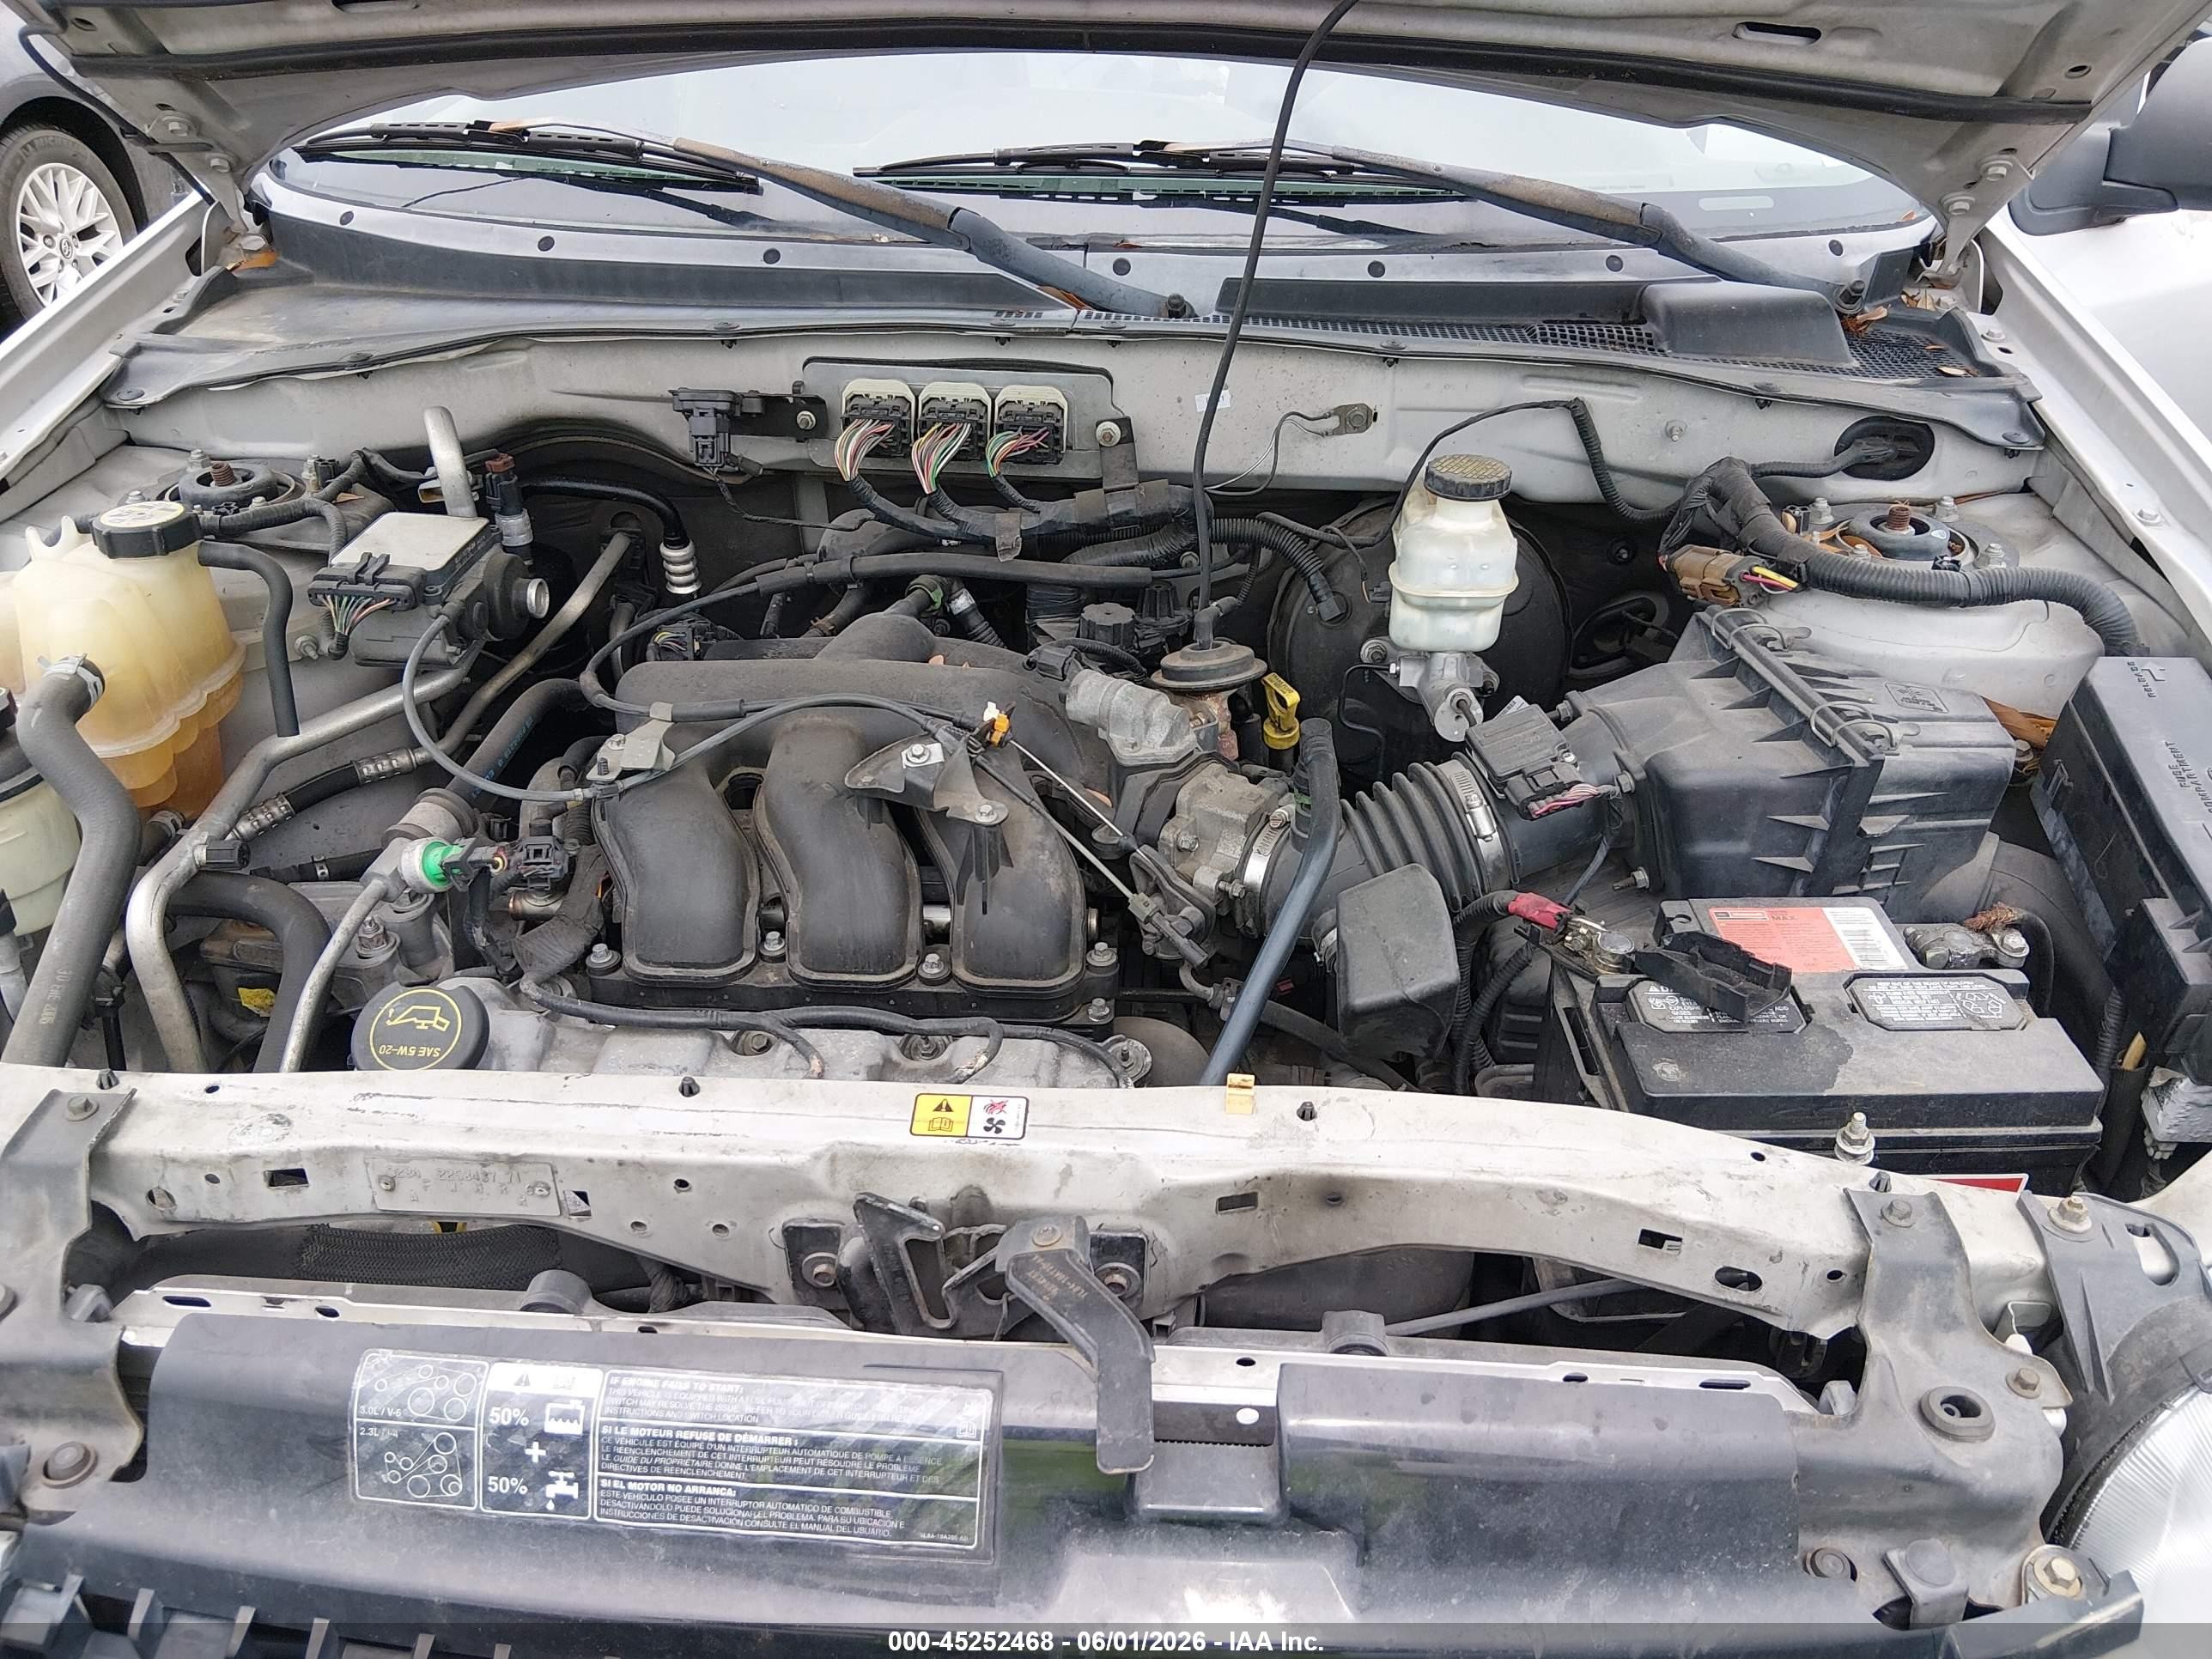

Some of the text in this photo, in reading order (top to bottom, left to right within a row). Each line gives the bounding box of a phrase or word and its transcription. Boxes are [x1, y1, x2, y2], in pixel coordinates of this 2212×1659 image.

[2168, 764, 2191, 788] FUSE
[379, 1044, 441, 1058] SAE 5W-20
[610, 1376, 620, 1386] IF
[622, 1377, 659, 1389] ENGINE
[693, 1382, 706, 1392] TO
[605, 1396, 638, 1407] SWITCH
[639, 1399, 656, 1407] MAY
[658, 1400, 696, 1410] RESOLVE
[697, 1402, 713, 1411] THE
[608, 1388, 626, 1396] THIS
[628, 1389, 661, 1399] VEHICLE
[673, 1391, 714, 1402] EQUIPPED
[716, 1394, 737, 1403] WITH
[360, 1406, 380, 1416] 3.0L
[388, 1407, 402, 1418] V-6
[489, 1407, 529, 1426] 50%
[605, 1407, 665, 1418] INSTRUCTIONS
[360, 1426, 379, 1437] 2.3L
[602, 1426, 612, 1435] SI
[615, 1427, 627, 1436] LE
[629, 1428, 673, 1438] MOTEUR
[675, 1431, 715, 1441] REFUSE
[719, 1433, 732, 1443] DE
[601, 1444, 611, 1453] LE
[697, 1450, 708, 1459] DE
[711, 1451, 726, 1460] CET
[729, 1453, 792, 1464] INTERRUPTEUR
[793, 1456, 815, 1466] PEUT
[864, 1461, 874, 1469] LE
[602, 1436, 612, 1444] CE
[657, 1439, 673, 1448] EST
[707, 1442, 726, 1451] D'UN
[727, 1443, 790, 1455] INTERRUPTEUR
[791, 1448, 850, 1459] AUTOMATIQUE
[852, 1451, 864, 1460] DE
[865, 1452, 894, 1462] POMPE
[601, 1462, 648, 1474] DIRECTIVES
[651, 1465, 663, 1474] DE
[613, 1455, 638, 1463] GUIDE
[715, 1461, 744, 1470] DONNE
[744, 1462, 812, 1474] L'EMPLACEMENT
[814, 1467, 824, 1475] DE
[827, 1468, 843, 1476] CET
[846, 1469, 908, 1480] INTERRUPTEUR
[909, 1473, 921, 1481] ET
[487, 1477, 528, 1496] 50%
[600, 1480, 736, 1497] SI EL MOTOR NO ARRANCA:
[600, 1490, 621, 1499] ESTE
[665, 1494, 692, 1504] POSEE
[695, 1496, 706, 1504] UN
[708, 1497, 765, 1509] INTERRUPTOR
[820, 1504, 832, 1513] DE
[599, 1509, 665, 1521] INSTRUCCIONES
[667, 1513, 679, 1522] DE
[744, 1517, 787, 1528] CONSULTE
[790, 1521, 799, 1529] EL
[801, 1521, 836, 1532] MANUAL
[837, 1523, 852, 1533] DEL
[854, 1524, 892, 1535] USUARIO.
[675, 1504, 702, 1514] PUEDE
[817, 1513, 838, 1522] PARA
[840, 1515, 851, 1523] SU
[900, 1518, 905, 1527] E
